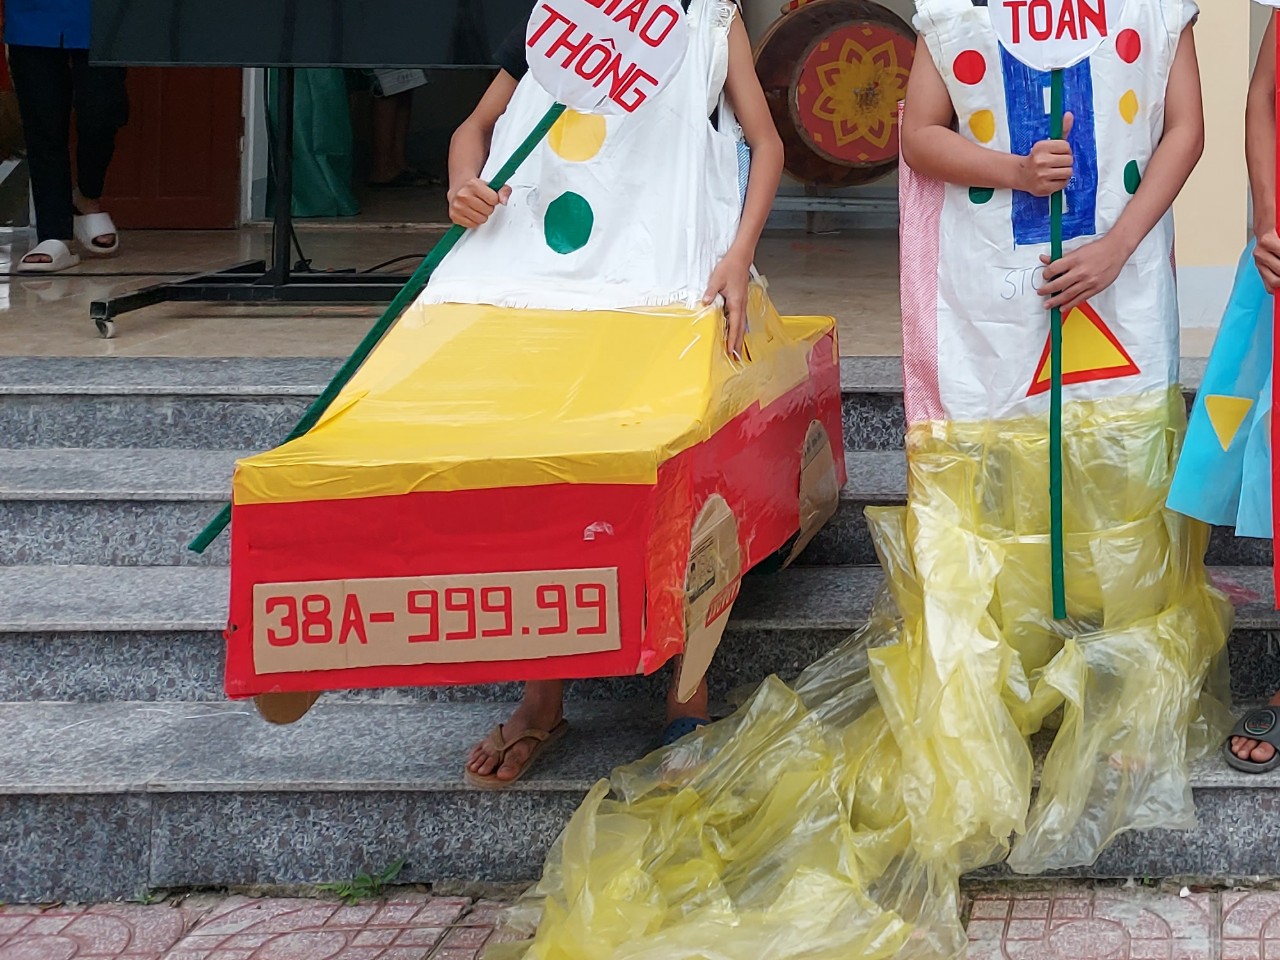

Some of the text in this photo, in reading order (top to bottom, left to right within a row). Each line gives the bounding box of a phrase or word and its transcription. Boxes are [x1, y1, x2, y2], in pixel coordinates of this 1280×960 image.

[527, 3, 658, 113] THÔNG
[1000, 265, 1048, 300] STO
[264, 582, 607, 647] 38A-999.99
